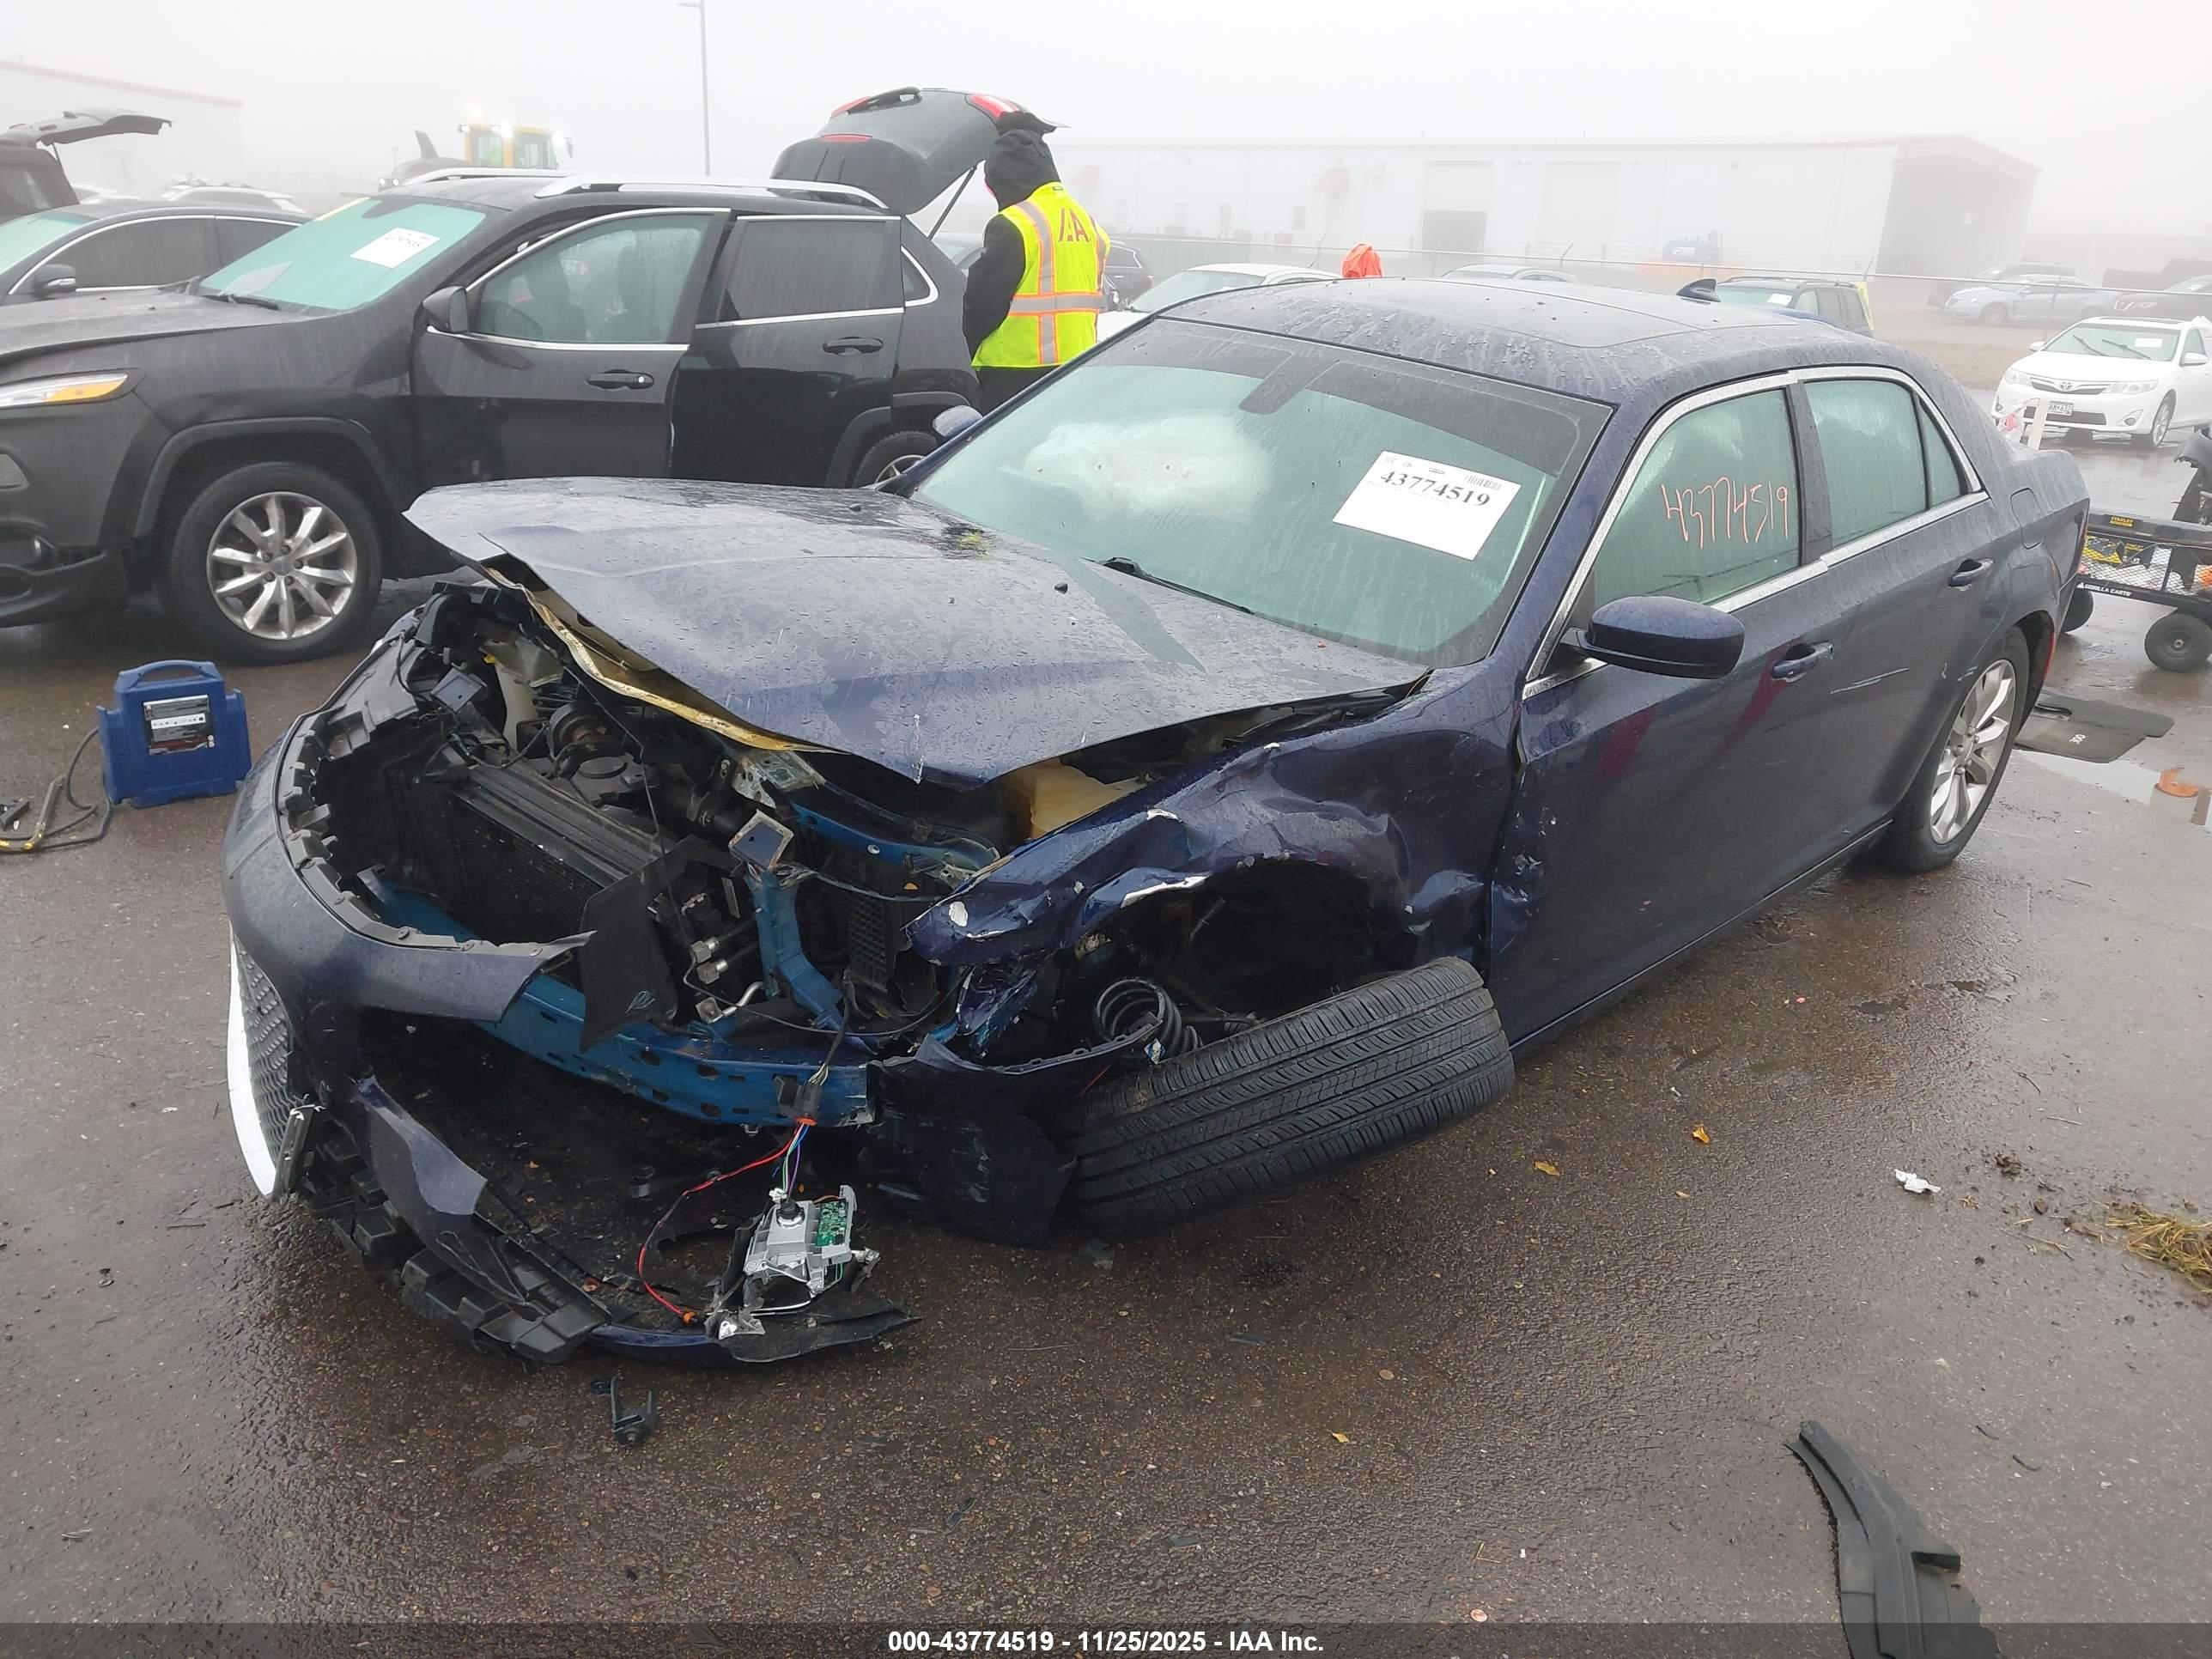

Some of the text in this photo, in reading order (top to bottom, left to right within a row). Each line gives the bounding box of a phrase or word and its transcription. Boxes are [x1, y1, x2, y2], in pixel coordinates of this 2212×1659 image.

[1380, 471, 1491, 506] 43774519
[1661, 477, 1788, 550] 43774519
[2084, 584, 2109, 592] GORILLA
